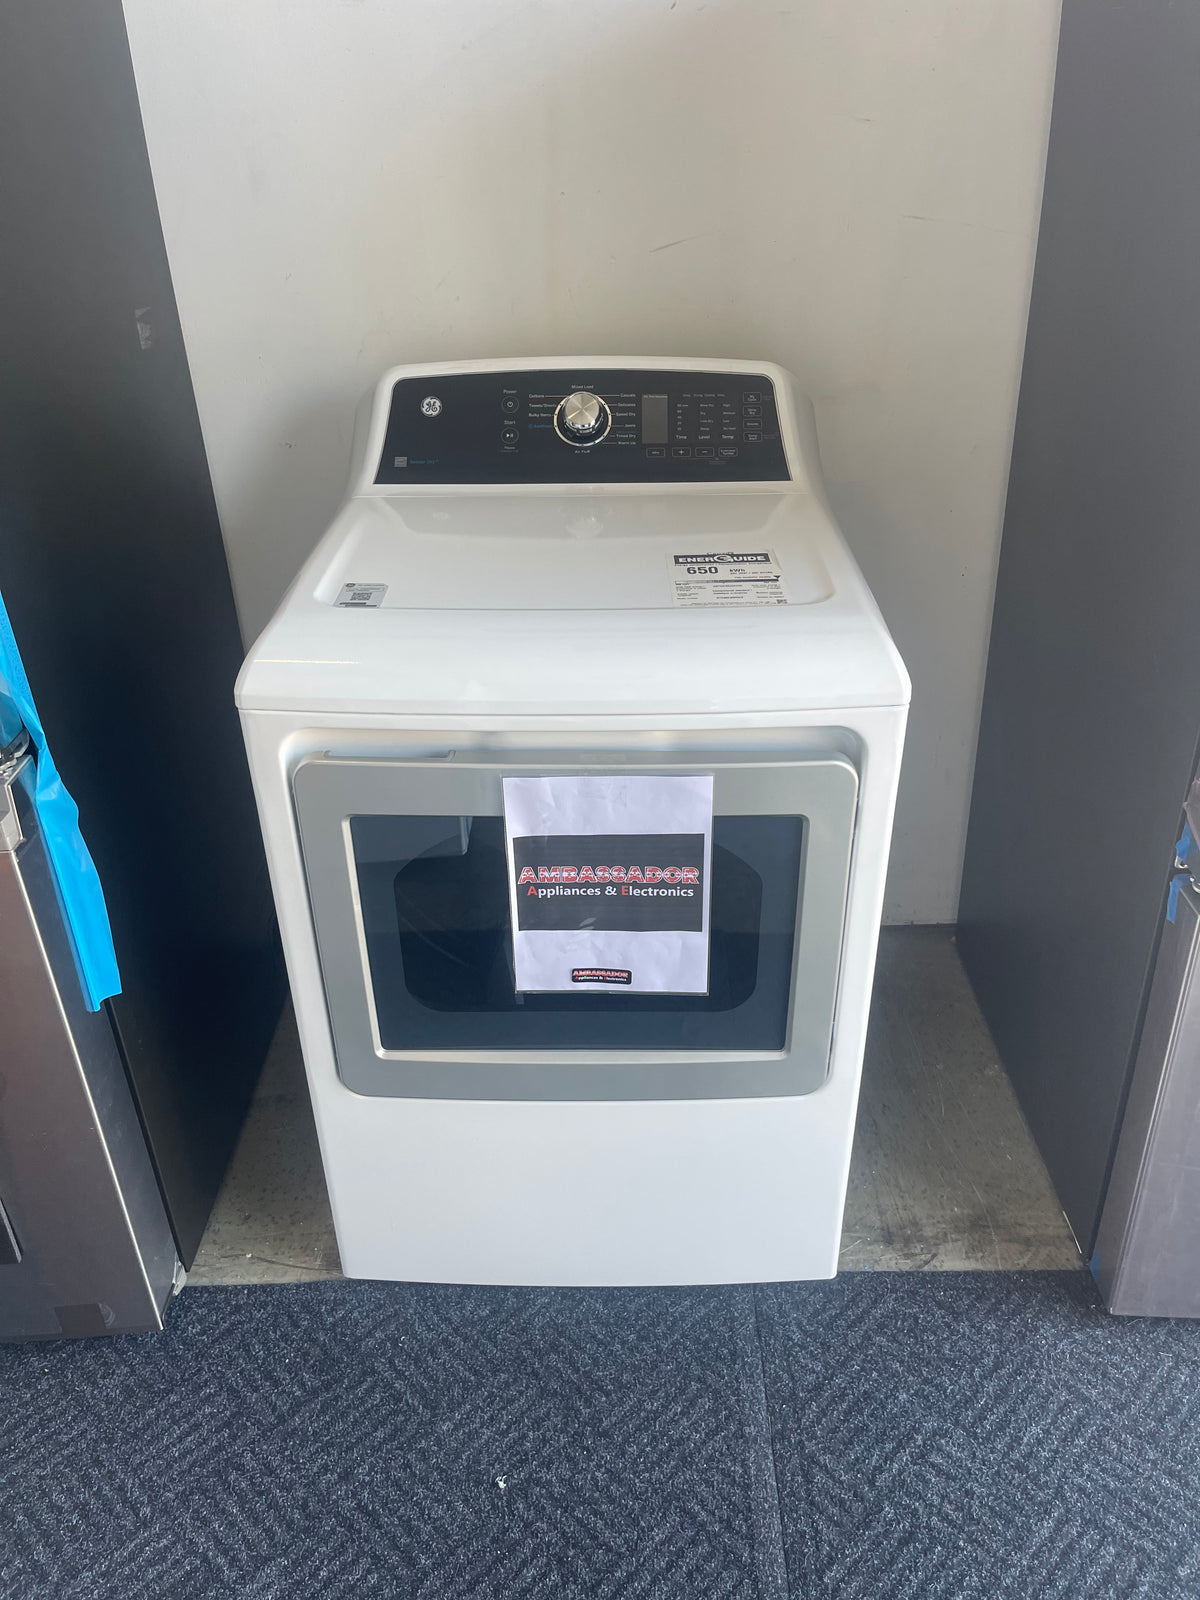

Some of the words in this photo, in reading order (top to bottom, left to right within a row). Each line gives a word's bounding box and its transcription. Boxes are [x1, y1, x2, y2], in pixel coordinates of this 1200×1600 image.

[678, 554, 766, 563] ENERGUIDE
[686, 566, 718, 574] 650
[518, 866, 700, 884] AMBASSADOR
[527, 886, 600, 898] Appliances
[604, 886, 618, 896] &
[621, 886, 694, 897] Electronics
[573, 970, 628, 978] AMBASSADOR
